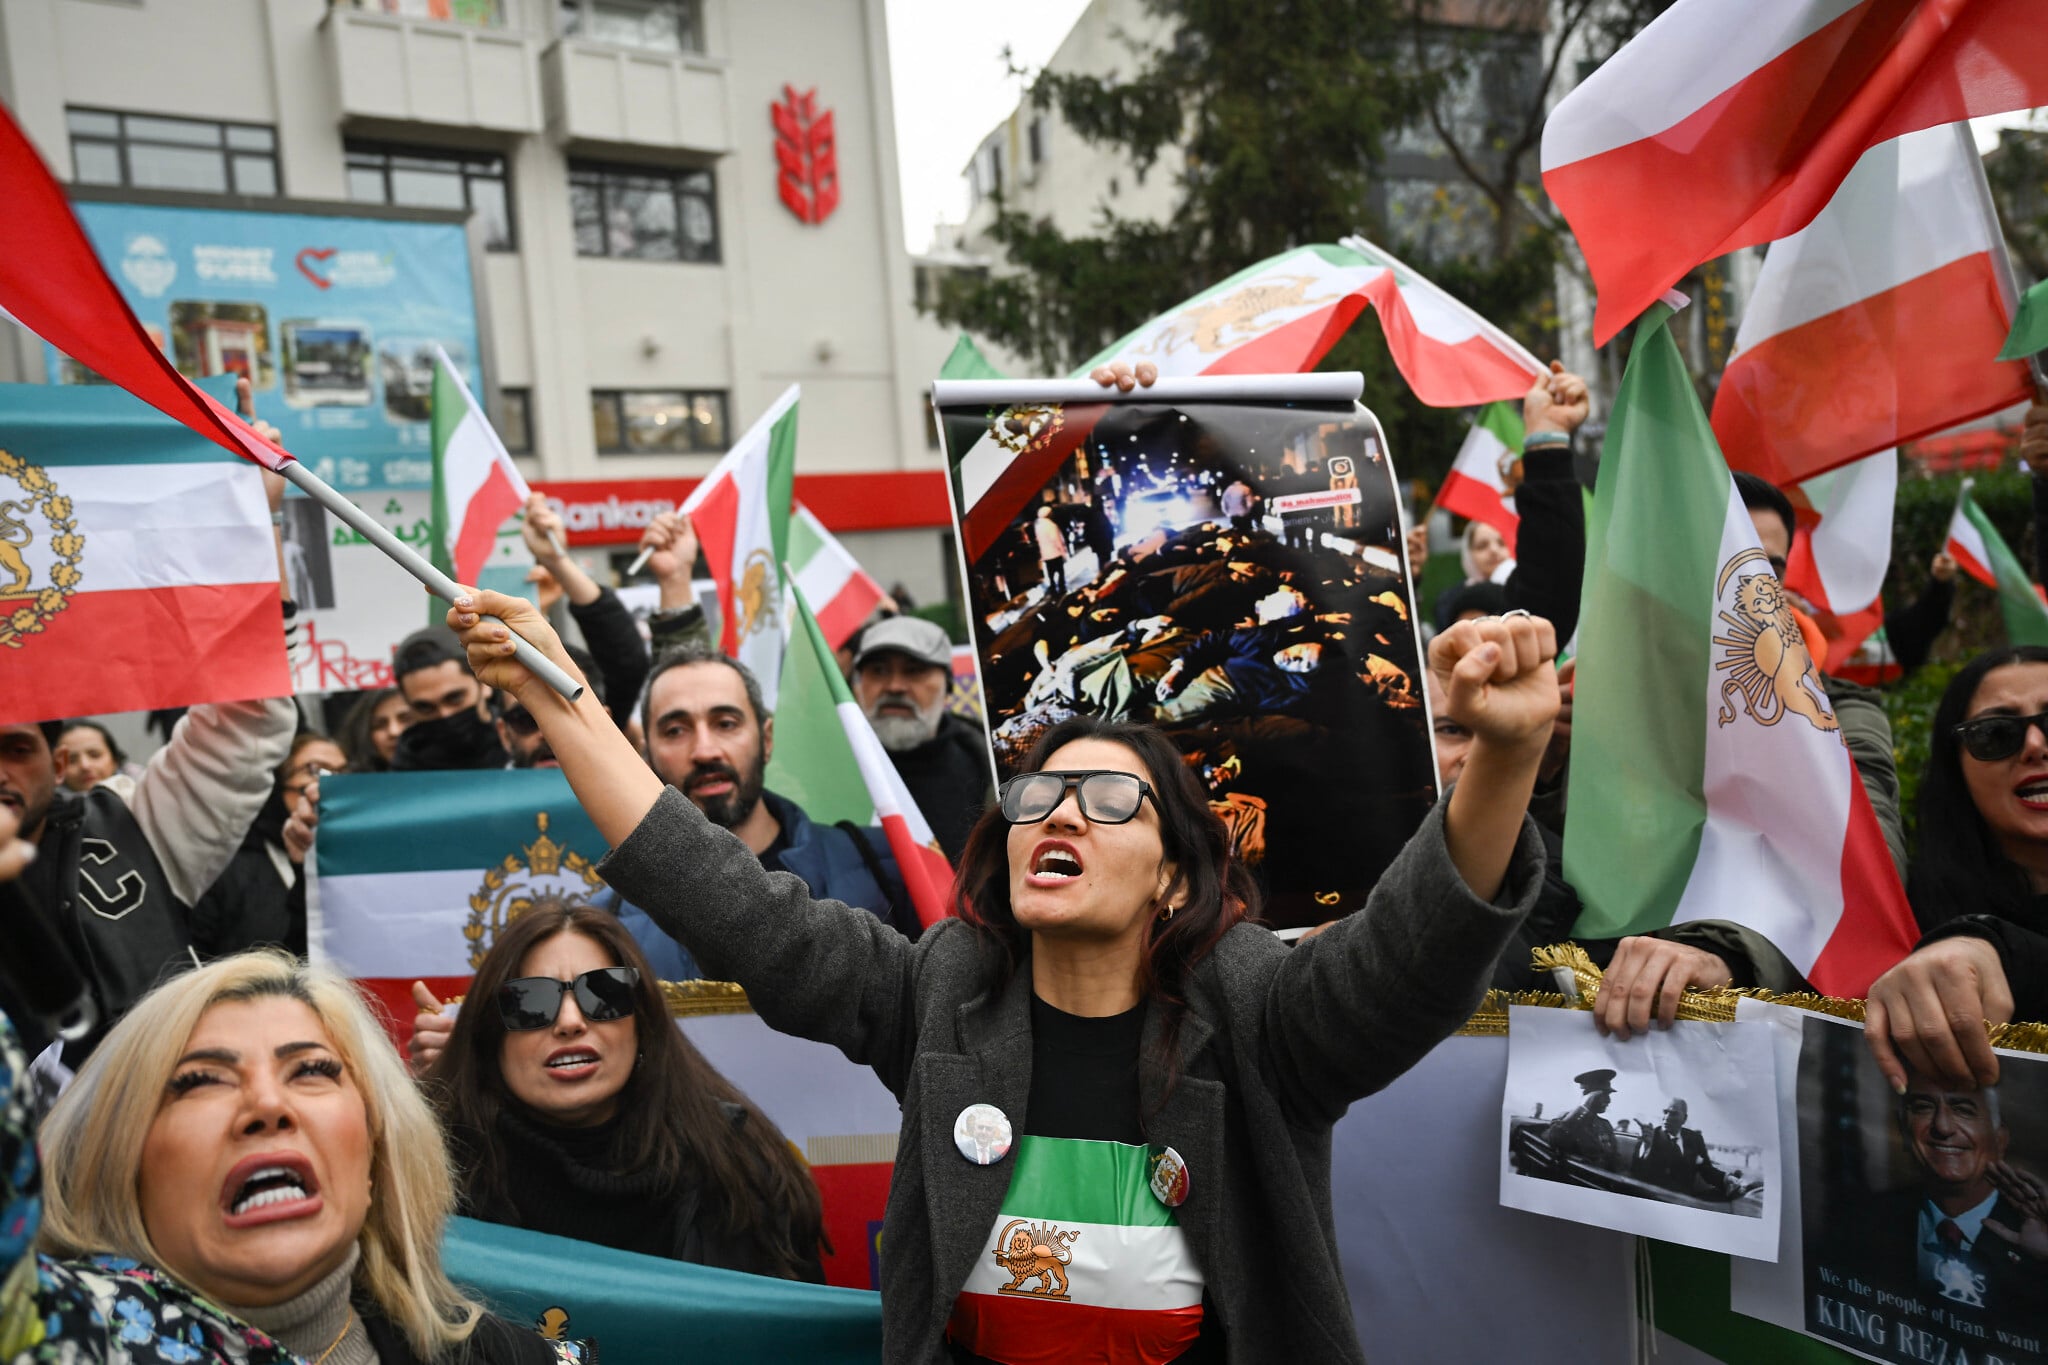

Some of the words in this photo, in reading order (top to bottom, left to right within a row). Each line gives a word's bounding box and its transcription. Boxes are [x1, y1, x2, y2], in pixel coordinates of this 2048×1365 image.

[1816, 1294, 1888, 1346] KING
[1896, 1321, 1970, 1365] REZA
[1848, 1277, 1873, 1297] the
[1877, 1289, 1927, 1315] people
[1931, 1308, 1946, 1325] of
[1996, 1329, 2041, 1355] want
